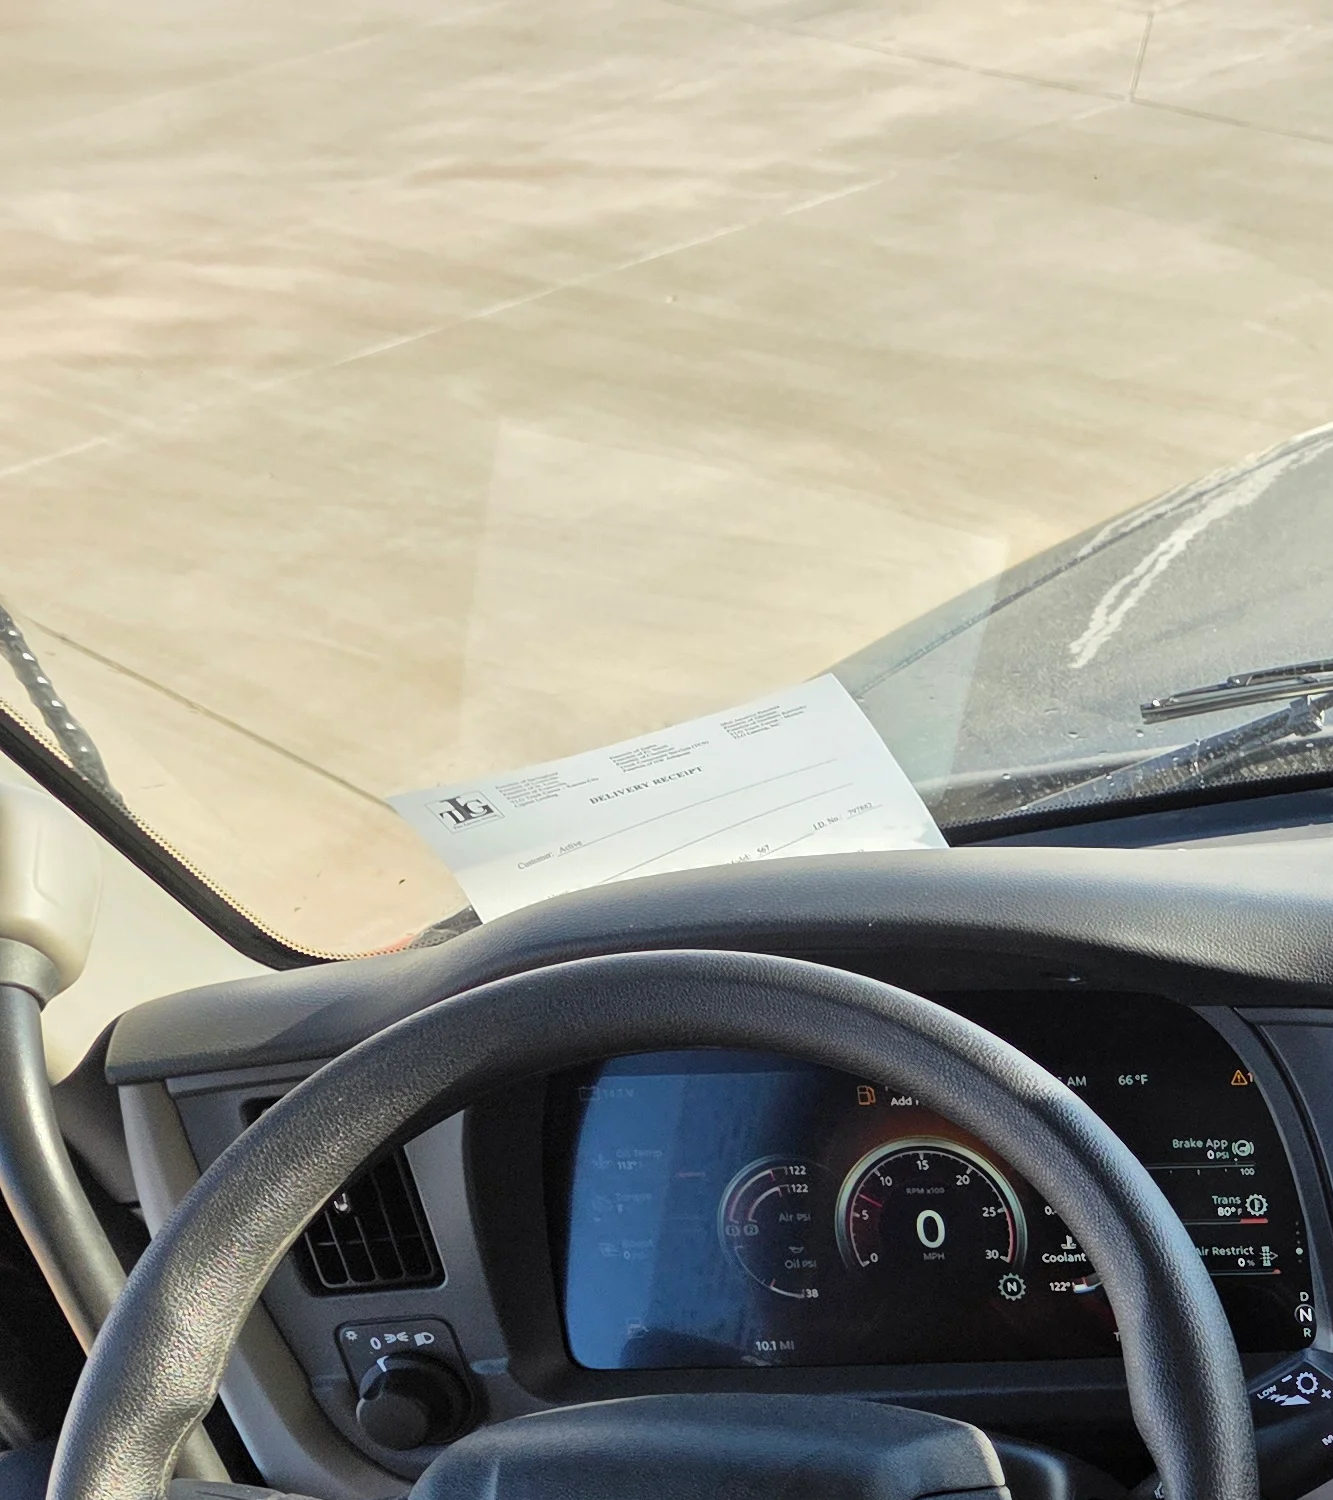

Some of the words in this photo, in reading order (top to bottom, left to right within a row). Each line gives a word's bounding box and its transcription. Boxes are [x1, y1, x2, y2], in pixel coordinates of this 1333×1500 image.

[589, 782, 650, 805] DELIVERY
[652, 766, 703, 785] RECEIPT
[558, 840, 583, 854] Active
[1067, 1077, 1087, 1086] AM
[890, 1097, 912, 1106] Add
[1172, 1139, 1203, 1149] Brake
[1206, 1139, 1228, 1150] App
[1207, 1150, 1214, 1159] 0
[1216, 1151, 1229, 1159] PSI
[916, 1160, 929, 1171] 15
[789, 1166, 807, 1176] 122
[1240, 1168, 1255, 1176] 100
[880, 1177, 892, 1186] 10
[956, 1175, 970, 1185] 20
[791, 1184, 808, 1193] 122
[906, 1187, 924, 1195] RPM
[1212, 1195, 1241, 1205] Trans
[779, 1213, 795, 1222] Air
[862, 1211, 869, 1220] 5
[982, 1207, 996, 1218] 25
[916, 1210, 946, 1249] 0
[985, 1250, 999, 1260] 30
[1212, 1246, 1254, 1256] Restrict
[870, 1253, 878, 1263] 0
[923, 1252, 945, 1261] MPH
[1042, 1252, 1087, 1263] Coolant
[784, 1259, 800, 1269] Oil
[1238, 1258, 1245, 1268] 0
[1007, 1282, 1018, 1292] N
[806, 1289, 819, 1298] 38
[1300, 1292, 1309, 1301] D
[1299, 1308, 1312, 1323] N
[1303, 1328, 1312, 1338] R
[755, 1341, 777, 1351] 10.1
[780, 1341, 795, 1351] MI
[1257, 1385, 1277, 1399] LOW
